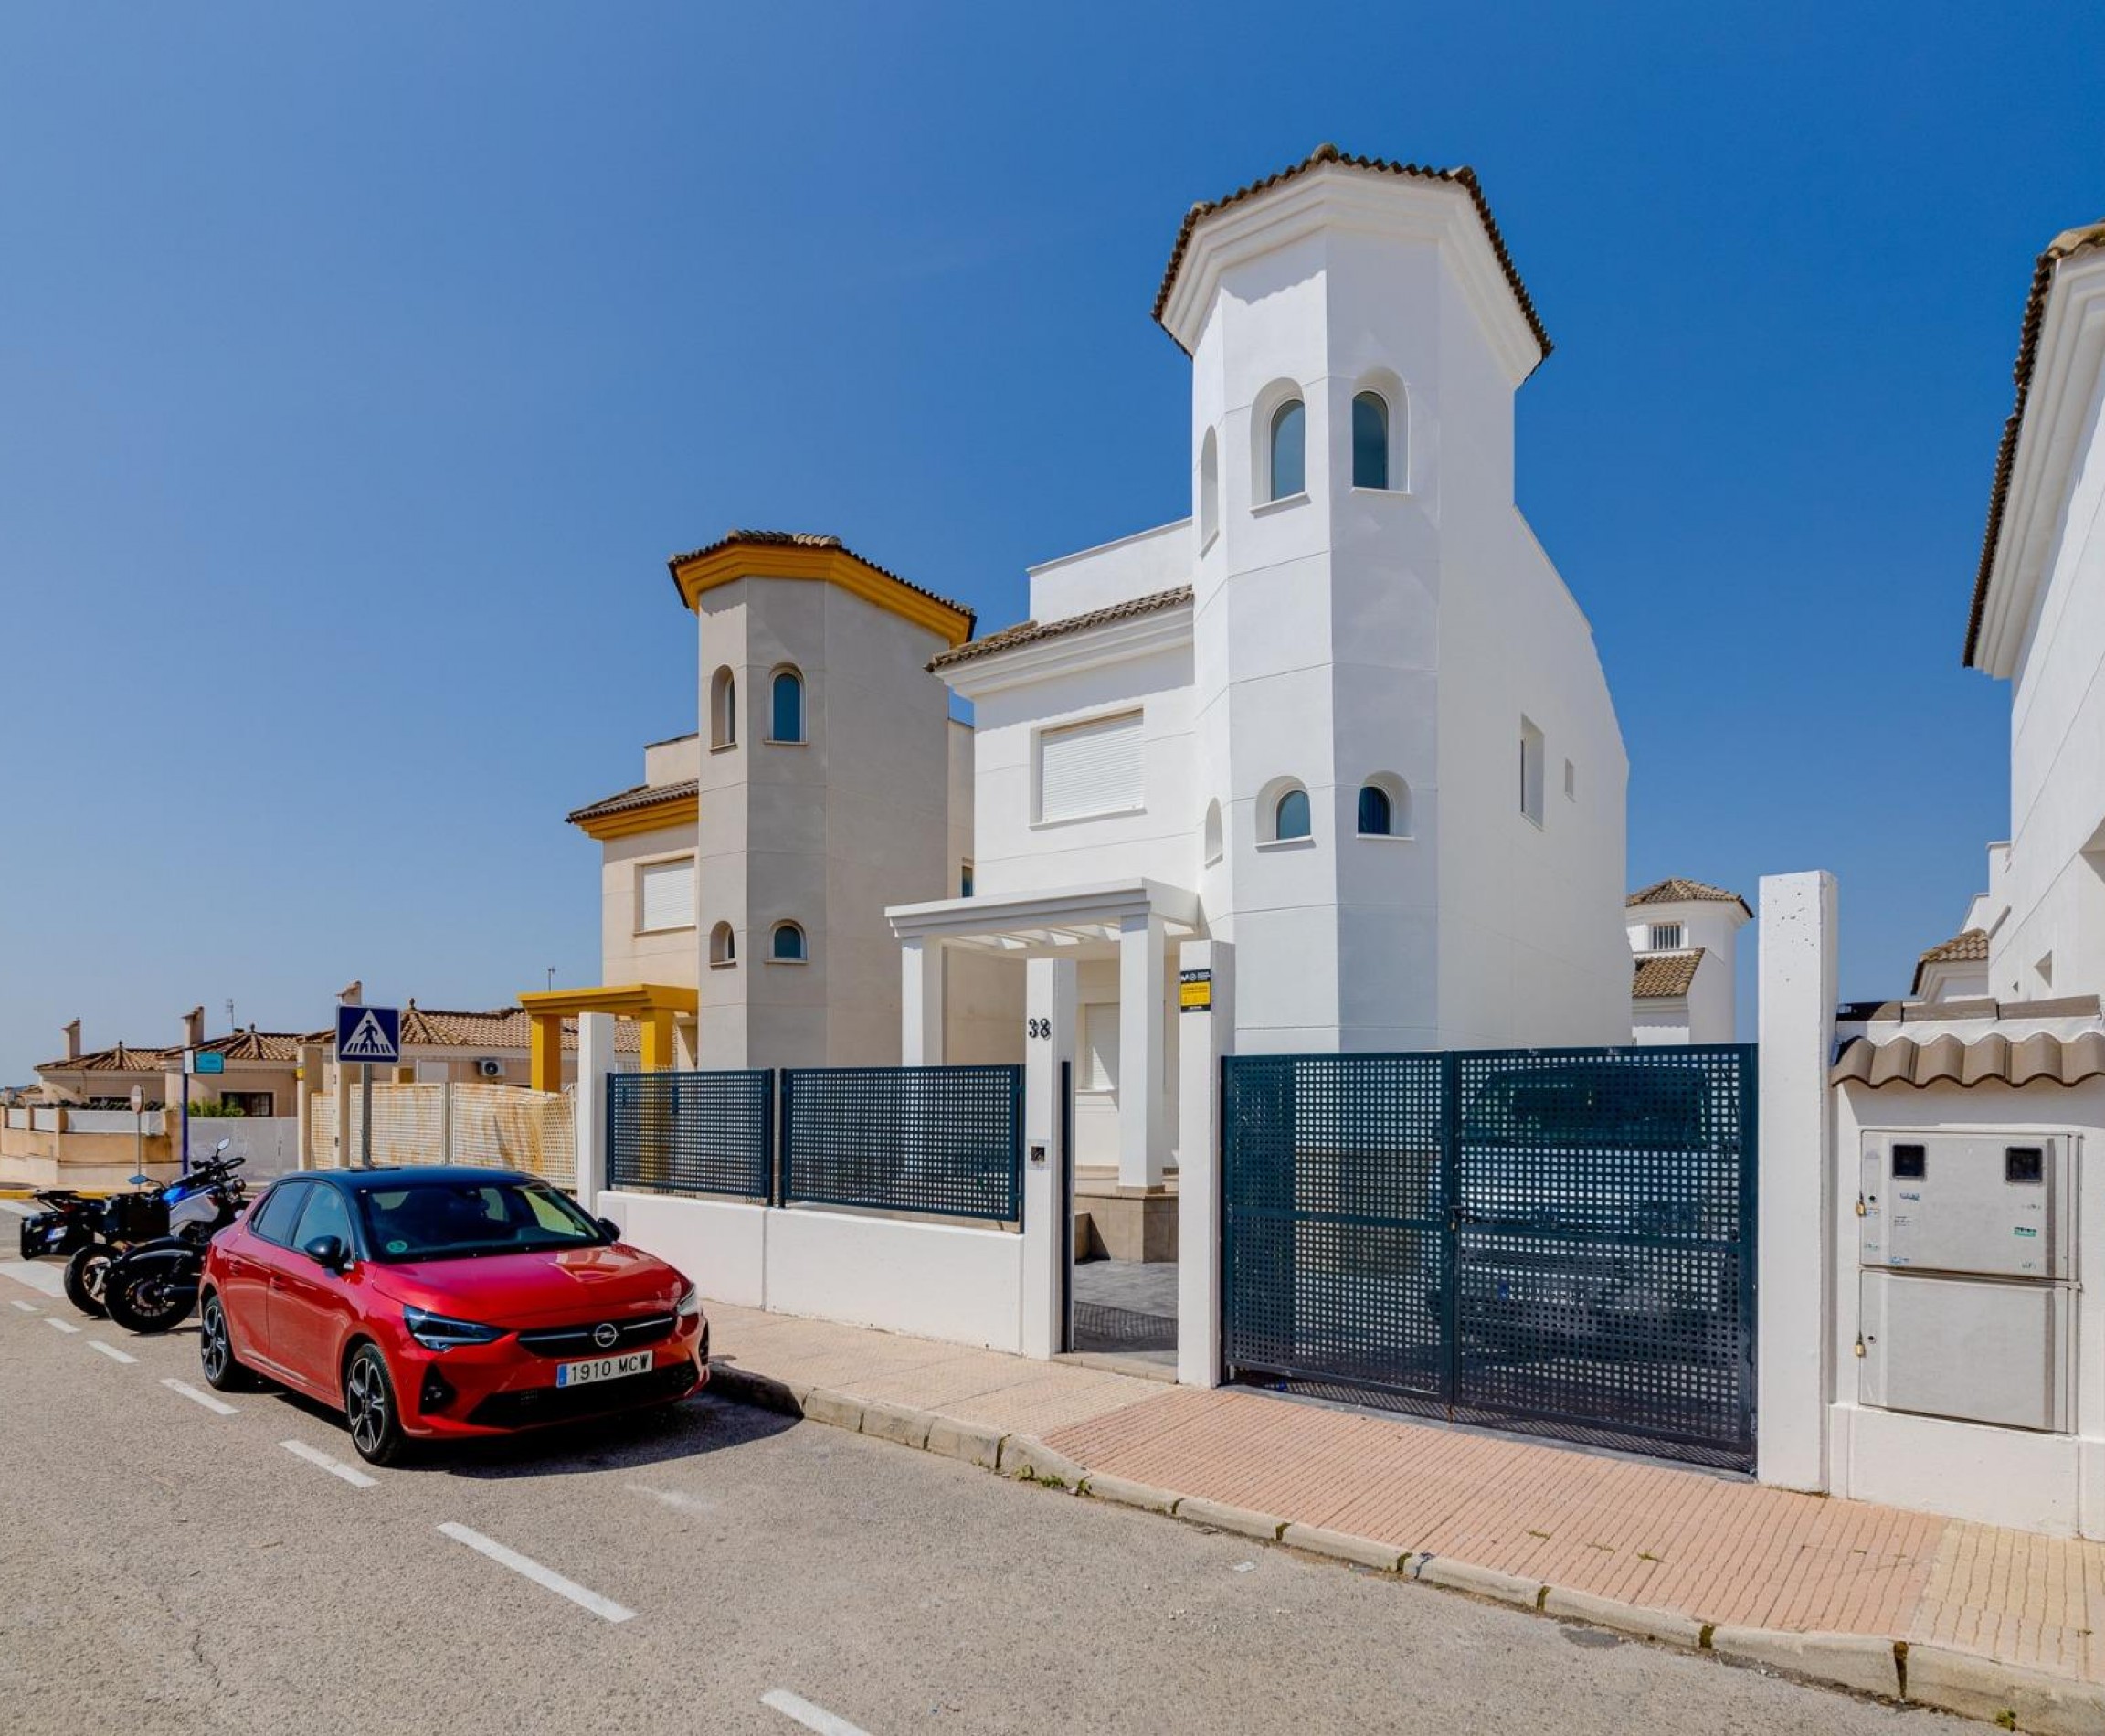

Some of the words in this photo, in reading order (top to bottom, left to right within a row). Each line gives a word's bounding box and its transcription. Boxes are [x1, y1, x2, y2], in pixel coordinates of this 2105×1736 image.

[1029, 1018, 1051, 1040] 38
[572, 1361, 611, 1381] 1910
[618, 1354, 649, 1373] MCW
